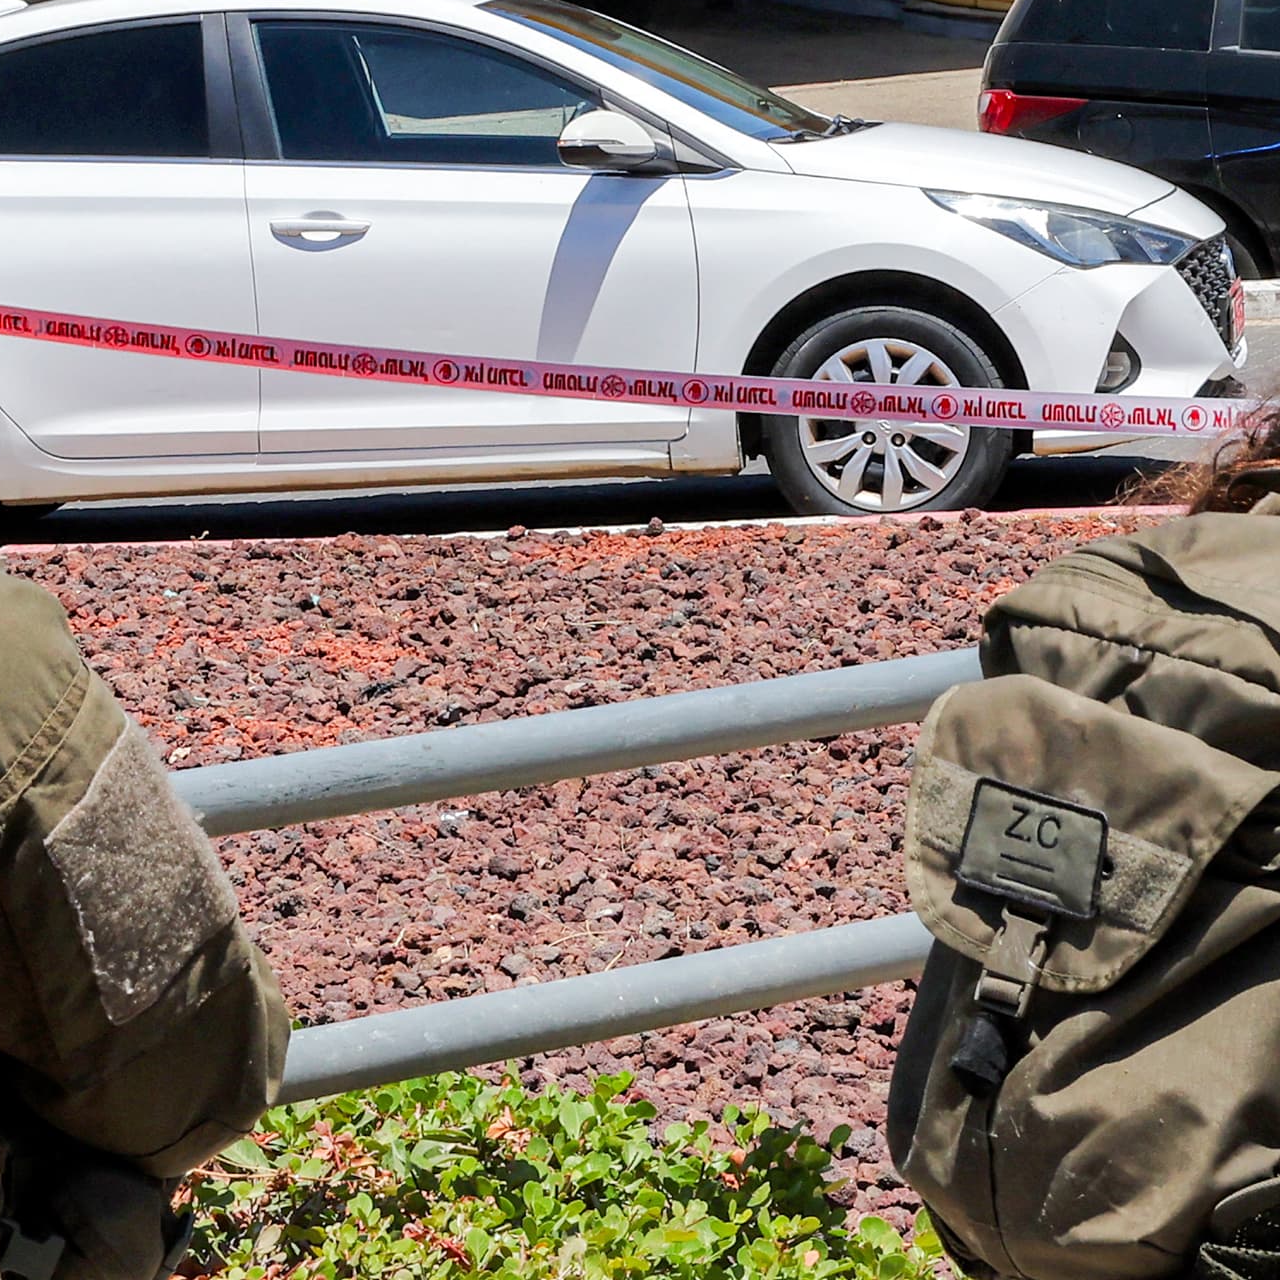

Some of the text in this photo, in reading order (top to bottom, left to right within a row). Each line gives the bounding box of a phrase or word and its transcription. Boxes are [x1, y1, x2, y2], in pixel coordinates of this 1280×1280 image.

[46, 319, 100, 342] משטרת
[131, 330, 180, 355] ישראל
[216, 338, 235, 359] אין
[238, 342, 280, 364] מעבר
[294, 349, 349, 371] משטרת
[380, 358, 429, 382] ישראל
[465, 363, 484, 384] אין
[487, 366, 528, 387] מעבר
[543, 372, 597, 393] משטרת
[628, 379, 677, 403] ישראל
[714, 382, 733, 403] אין
[736, 386, 777, 407] מעבר
[792, 390, 847, 411] משטרת
[878, 395, 927, 419] ישראל
[963, 395, 982, 418] אין
[986, 400, 1027, 420] מעבר
[1042, 402, 1097, 424] משטרת
[1127, 407, 1177, 431] ישראל
